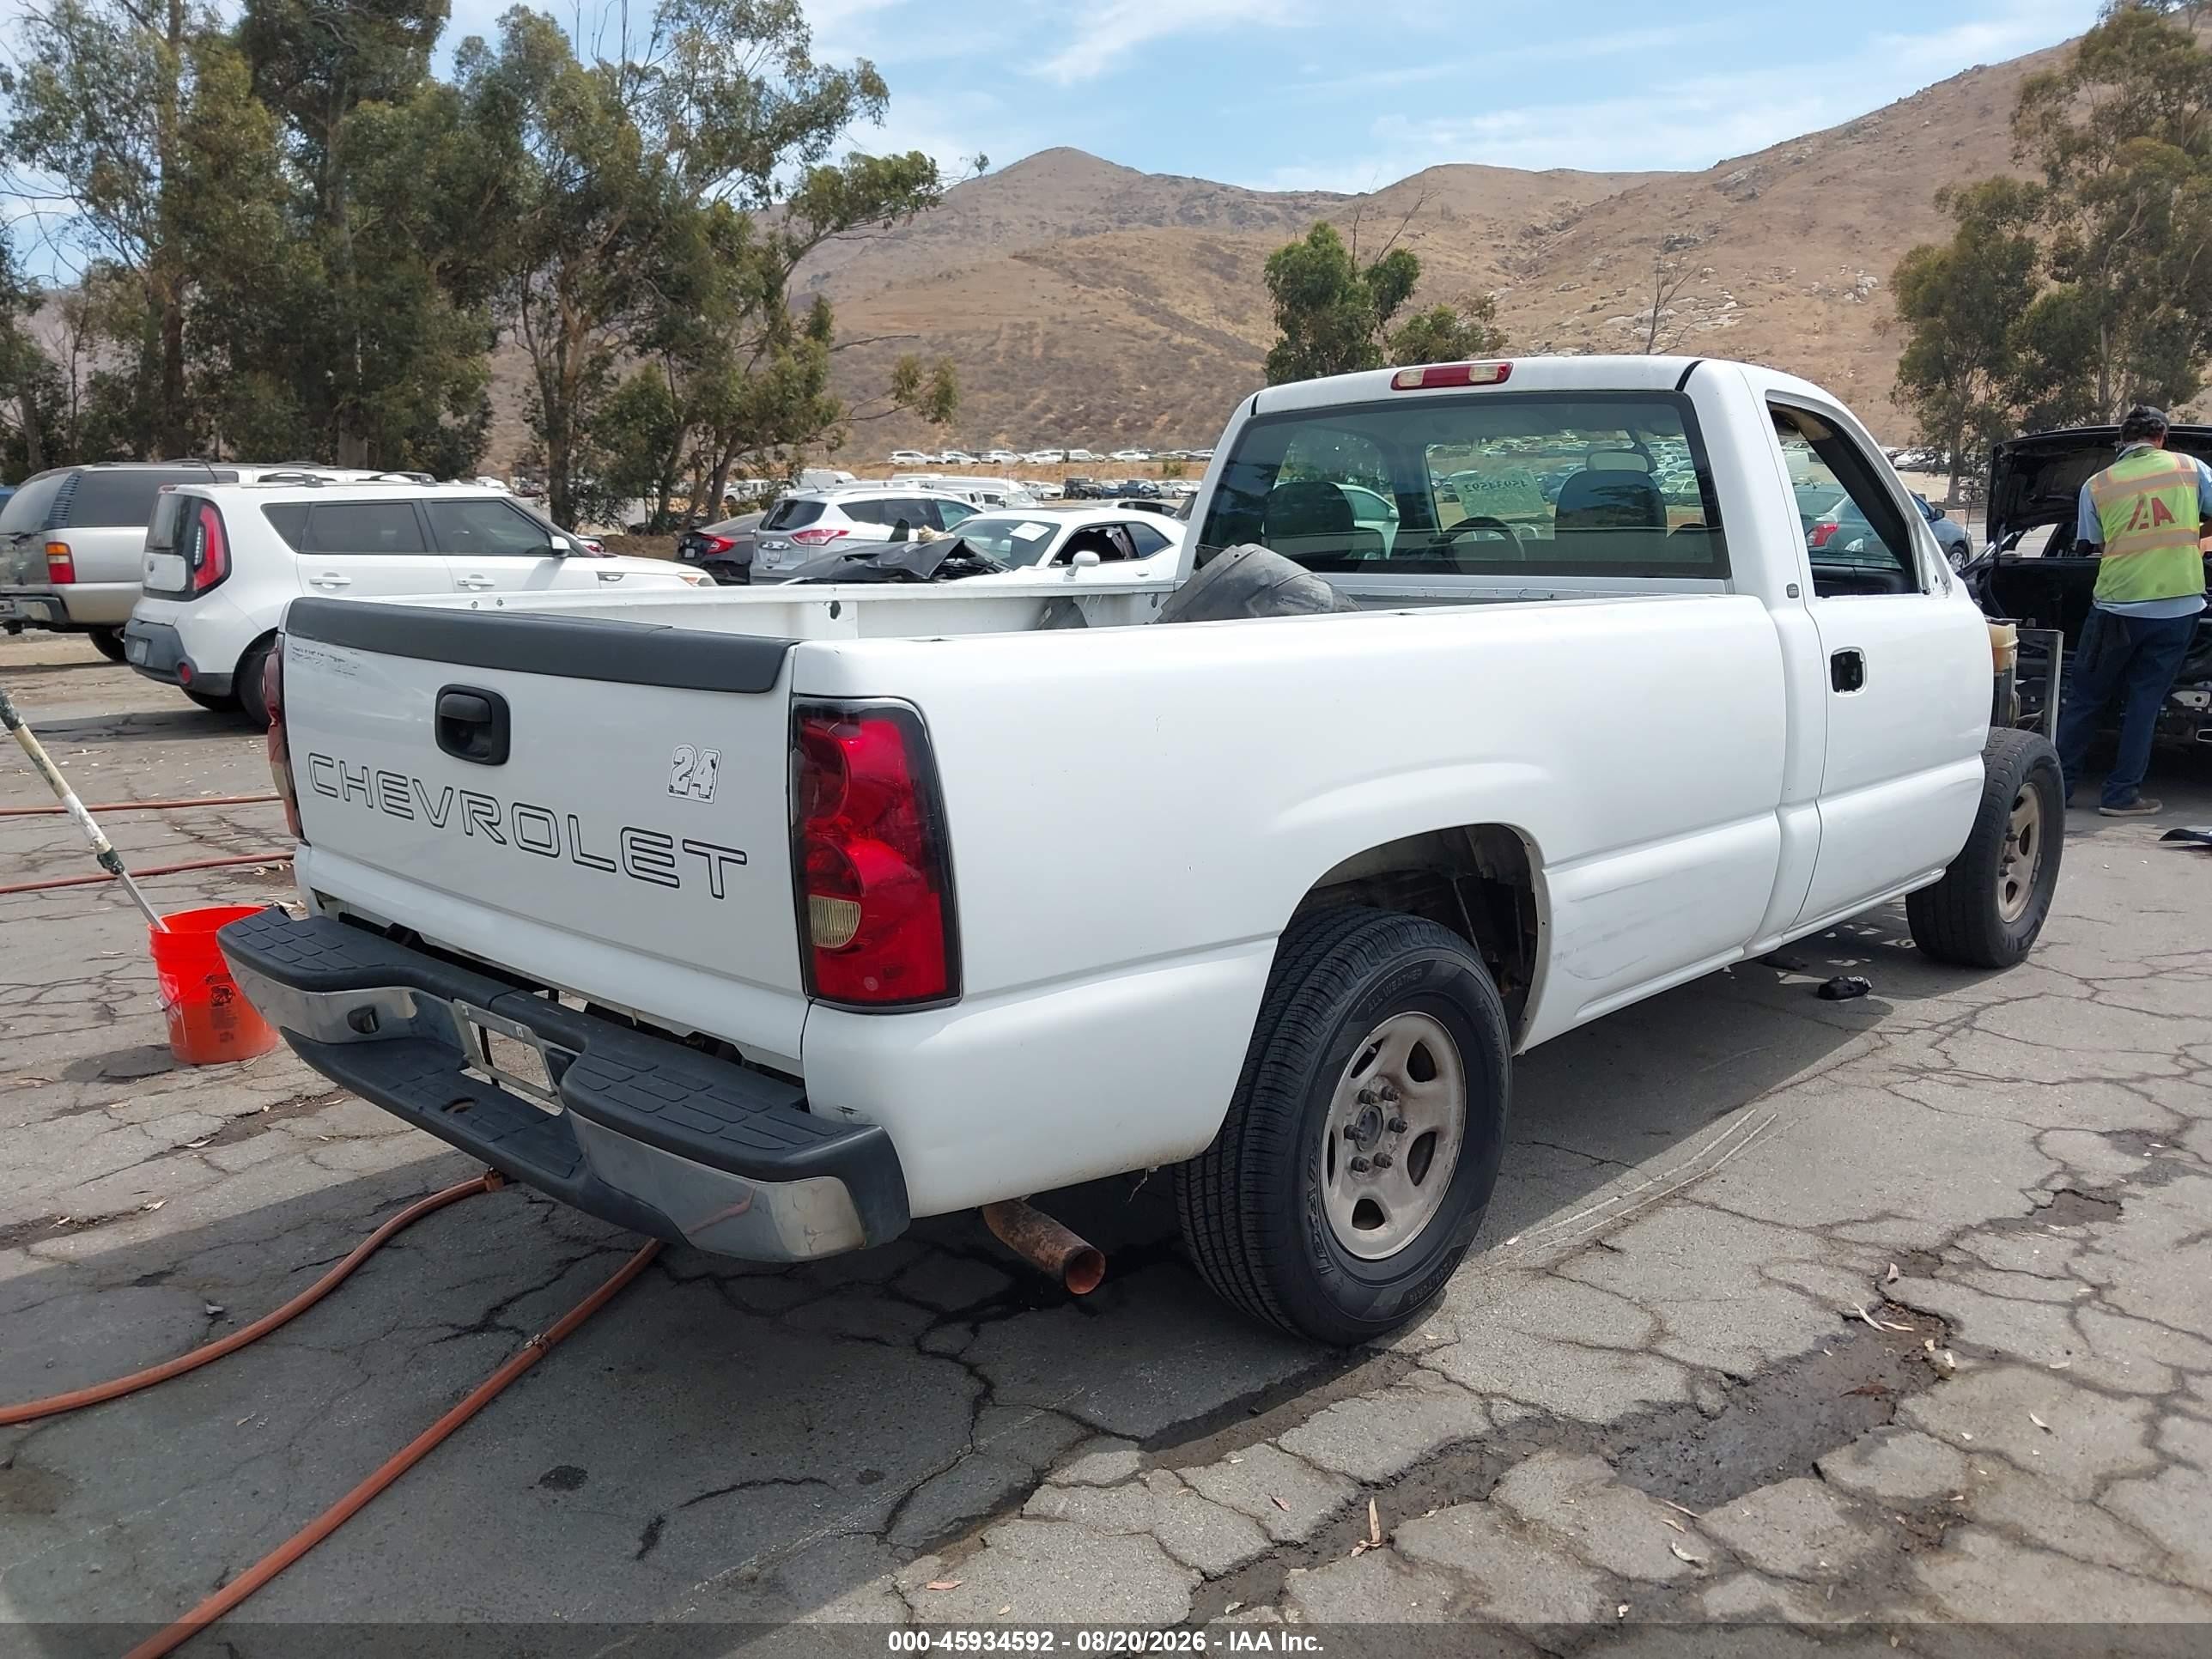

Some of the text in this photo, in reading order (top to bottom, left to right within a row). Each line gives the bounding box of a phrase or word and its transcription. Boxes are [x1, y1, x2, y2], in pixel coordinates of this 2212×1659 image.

[668, 744, 721, 803] 24
[307, 752, 748, 900] CHEVROLET
[1367, 969, 1424, 1014] ALL WEATHER
